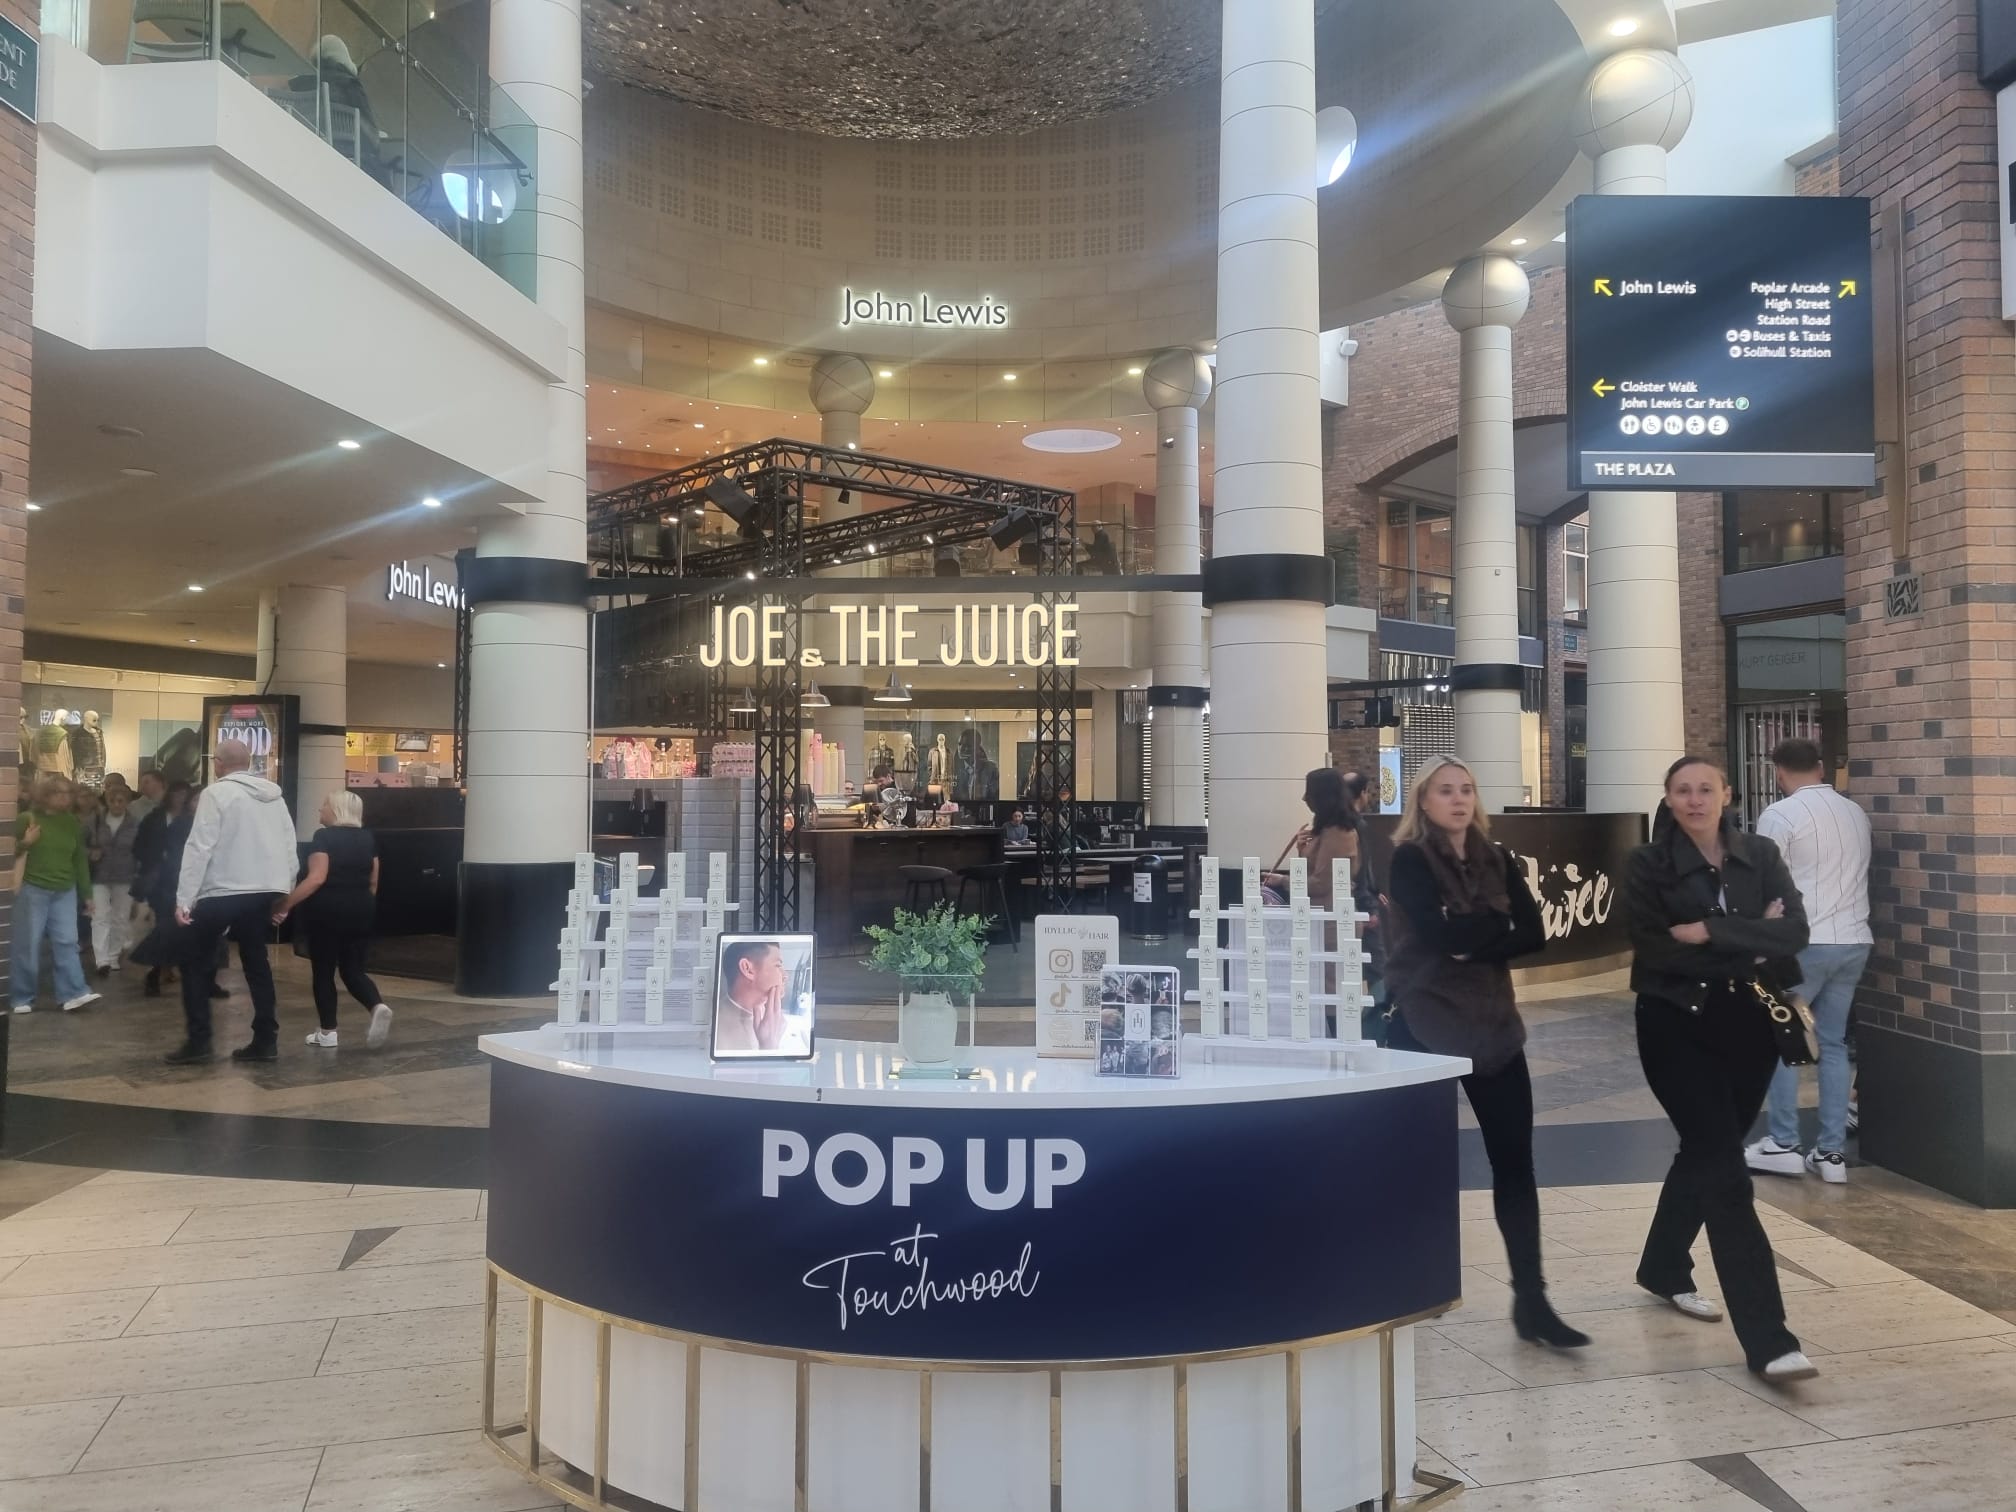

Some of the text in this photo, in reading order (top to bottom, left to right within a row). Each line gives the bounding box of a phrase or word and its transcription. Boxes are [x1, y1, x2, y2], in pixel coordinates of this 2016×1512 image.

[1620, 280, 1697, 296] John Lewis
[1751, 281, 1831, 296] Poplar Arcade
[841, 287, 1007, 327] John Lewis
[1765, 298, 1832, 312] High Street
[1757, 314, 1831, 326] Station Road
[1752, 330, 1832, 342] Buses & Taxis
[1743, 346, 1832, 358] Solihull Station
[1620, 381, 1699, 393] Cloister Walk
[1620, 397, 1648, 411] John
[1650, 397, 1683, 409] Lewis
[1685, 398, 1707, 409] Car
[1708, 397, 1736, 409] Park
[1594, 462, 1677, 476] THE PLAZA
[387, 559, 475, 613] John Lewi
[699, 604, 787, 667] JOE
[799, 647, 826, 668] &
[829, 604, 919, 667] THE
[939, 603, 1080, 667] JUICE
[1767, 652, 1808, 667] GEIGER
[1044, 927, 1110, 941] IDYLLIC HAIR
[762, 1128, 1087, 1211] POP UP
[890, 1222, 939, 1267] at
[802, 1241, 1041, 1331] Touchwood
